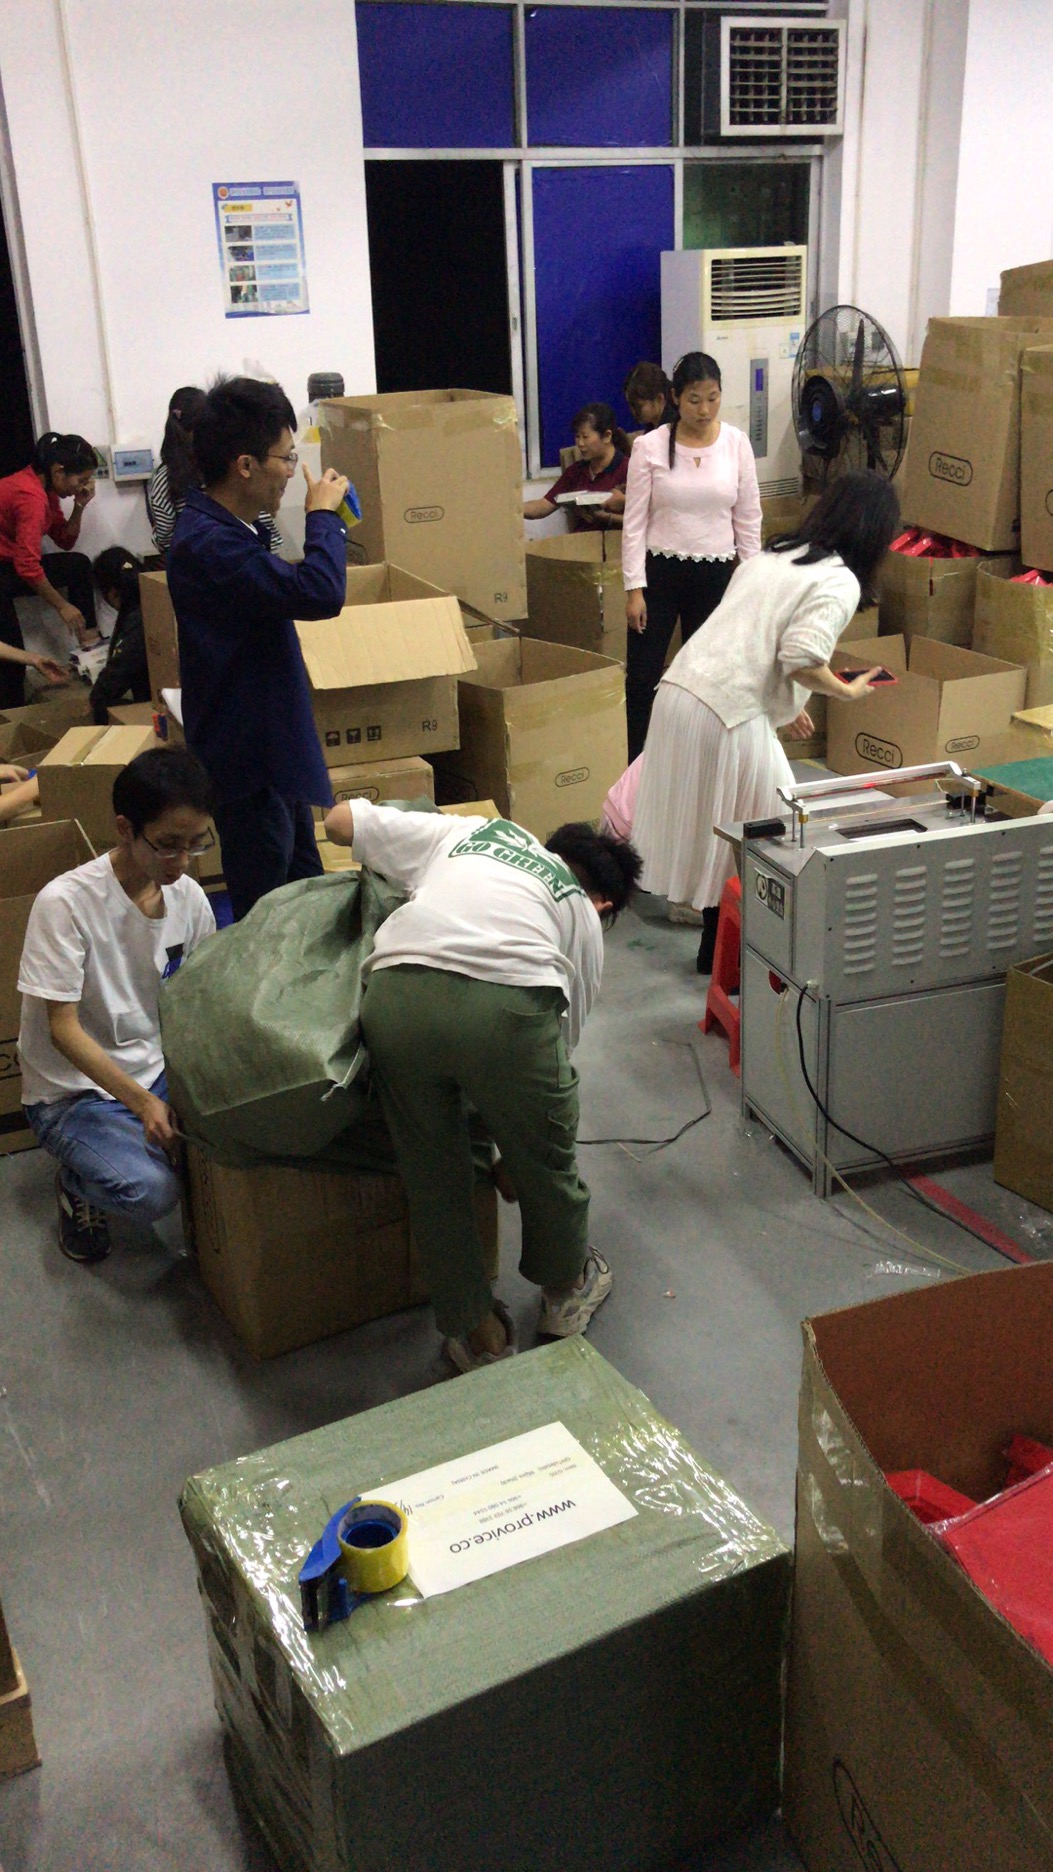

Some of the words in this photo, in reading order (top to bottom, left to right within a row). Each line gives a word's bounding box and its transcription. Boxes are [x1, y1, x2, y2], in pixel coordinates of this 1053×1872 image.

[935, 459, 966, 480] Recci
[410, 508, 440, 521] Recci
[494, 592, 508, 604] R9
[422, 719, 438, 732] R9
[863, 738, 895, 764] Recci
[951, 738, 975, 751] Recci
[561, 773, 585, 784] Recci
[456, 841, 491, 854] GO
[493, 848, 564, 895] GREEN
[449, 1499, 577, 1554] www.provice.co
